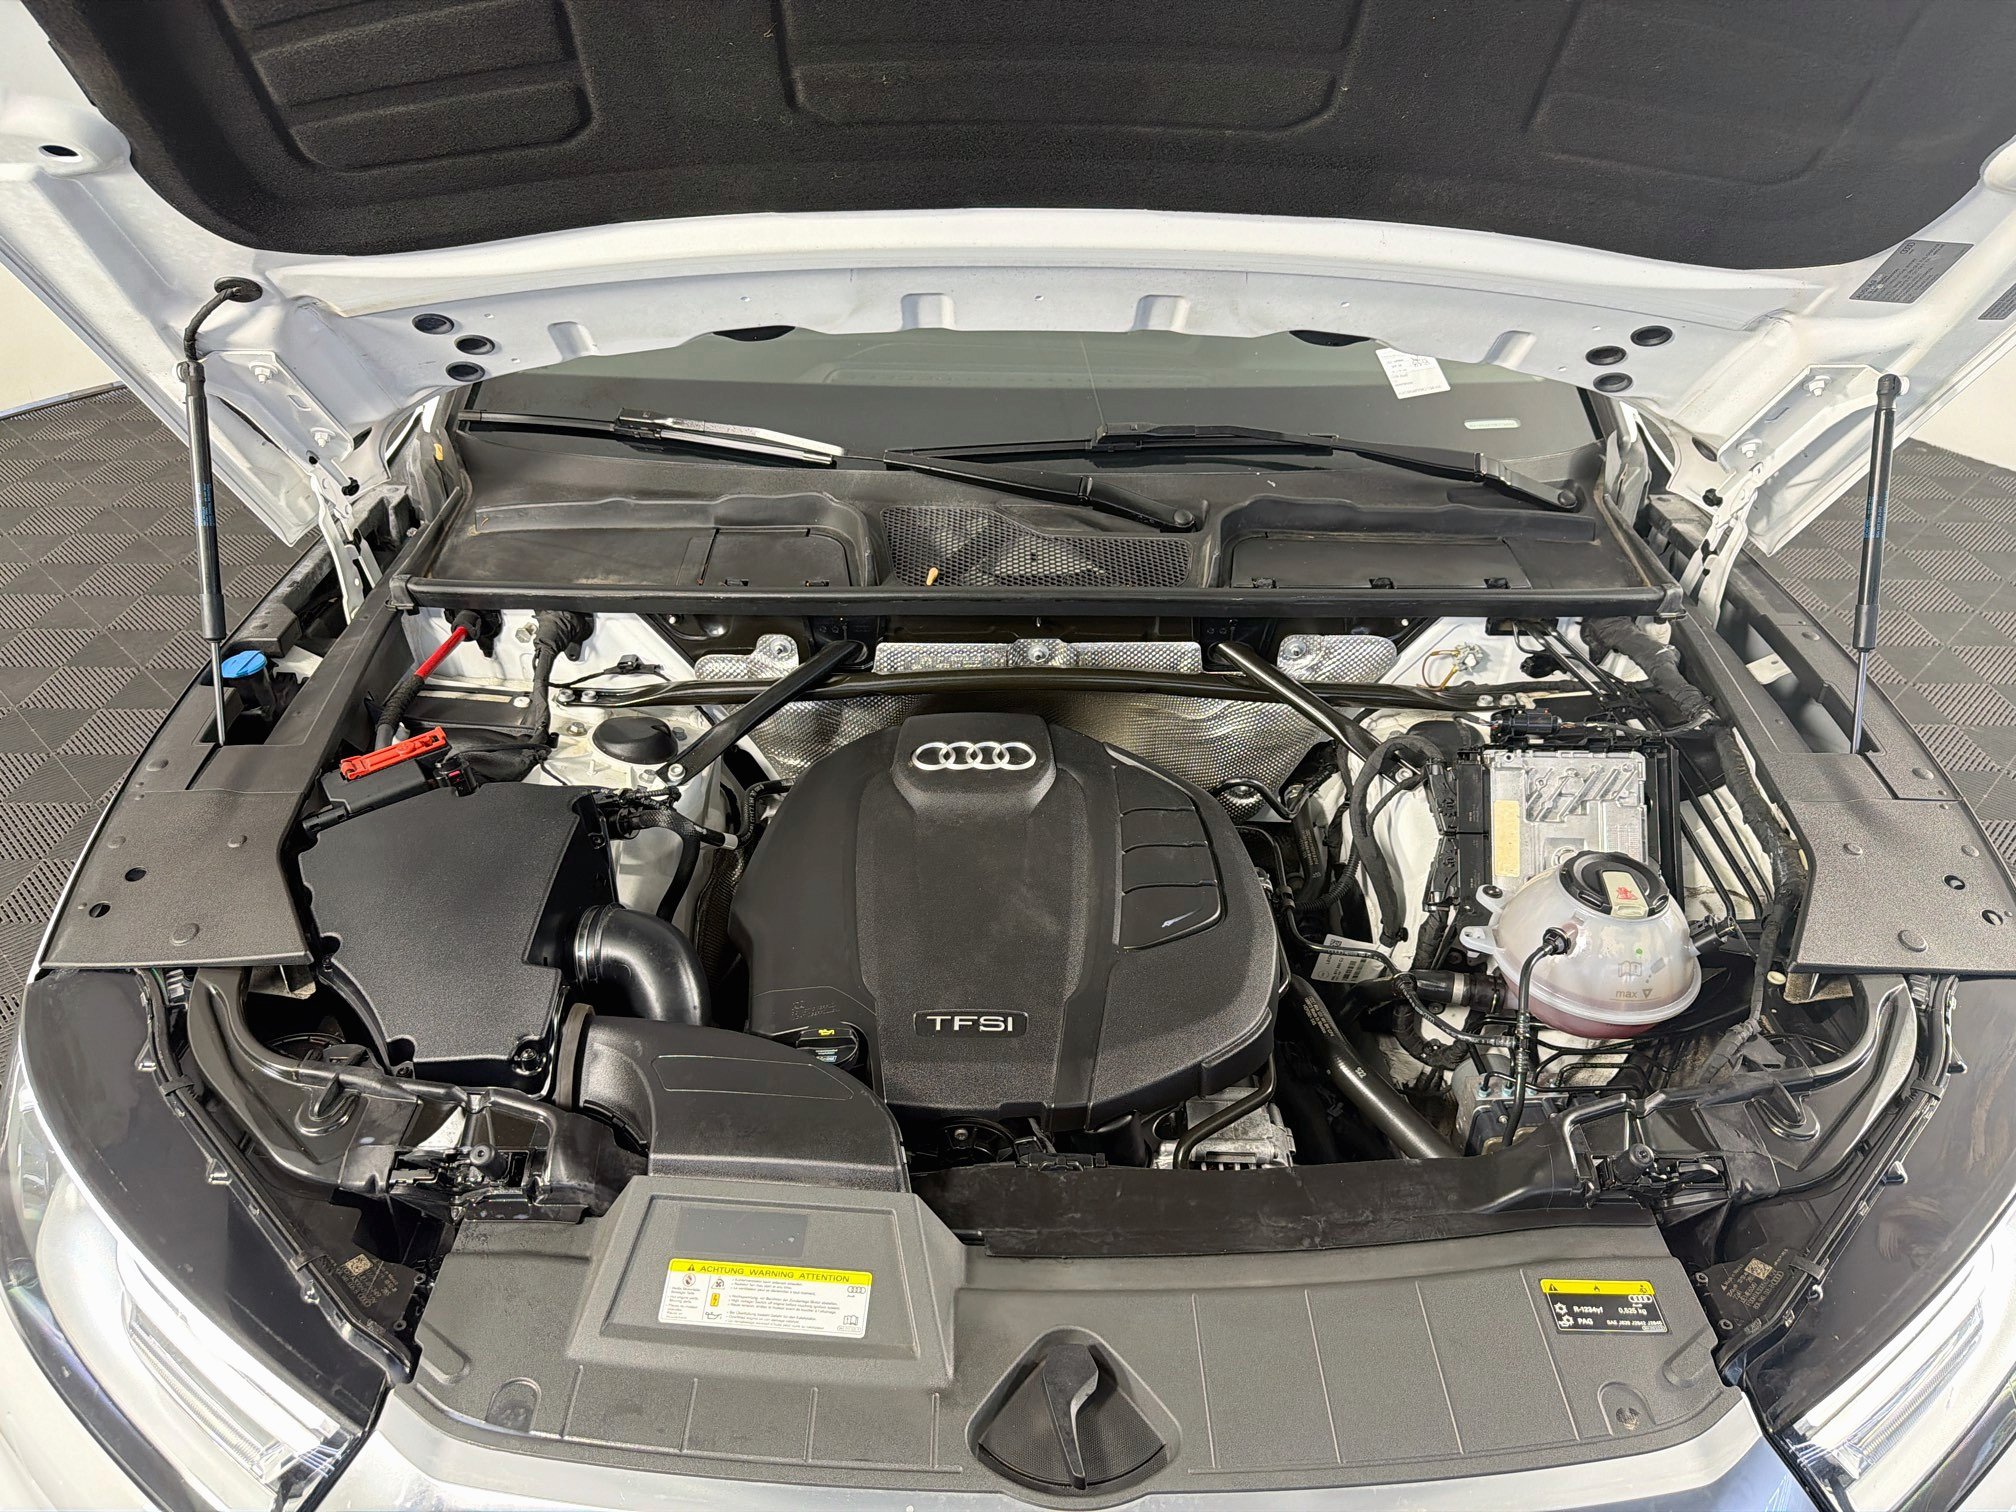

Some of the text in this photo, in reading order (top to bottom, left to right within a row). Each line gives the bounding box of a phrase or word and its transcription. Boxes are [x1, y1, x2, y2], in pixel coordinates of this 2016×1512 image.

[1615, 990, 1638, 999] max
[926, 1015, 1013, 1032] TFSI
[699, 1265, 744, 1275] ACHTUNG
[749, 1268, 794, 1279] WARNING
[798, 1272, 850, 1283] ATTENTION
[1577, 1317, 1594, 1326] PAG
